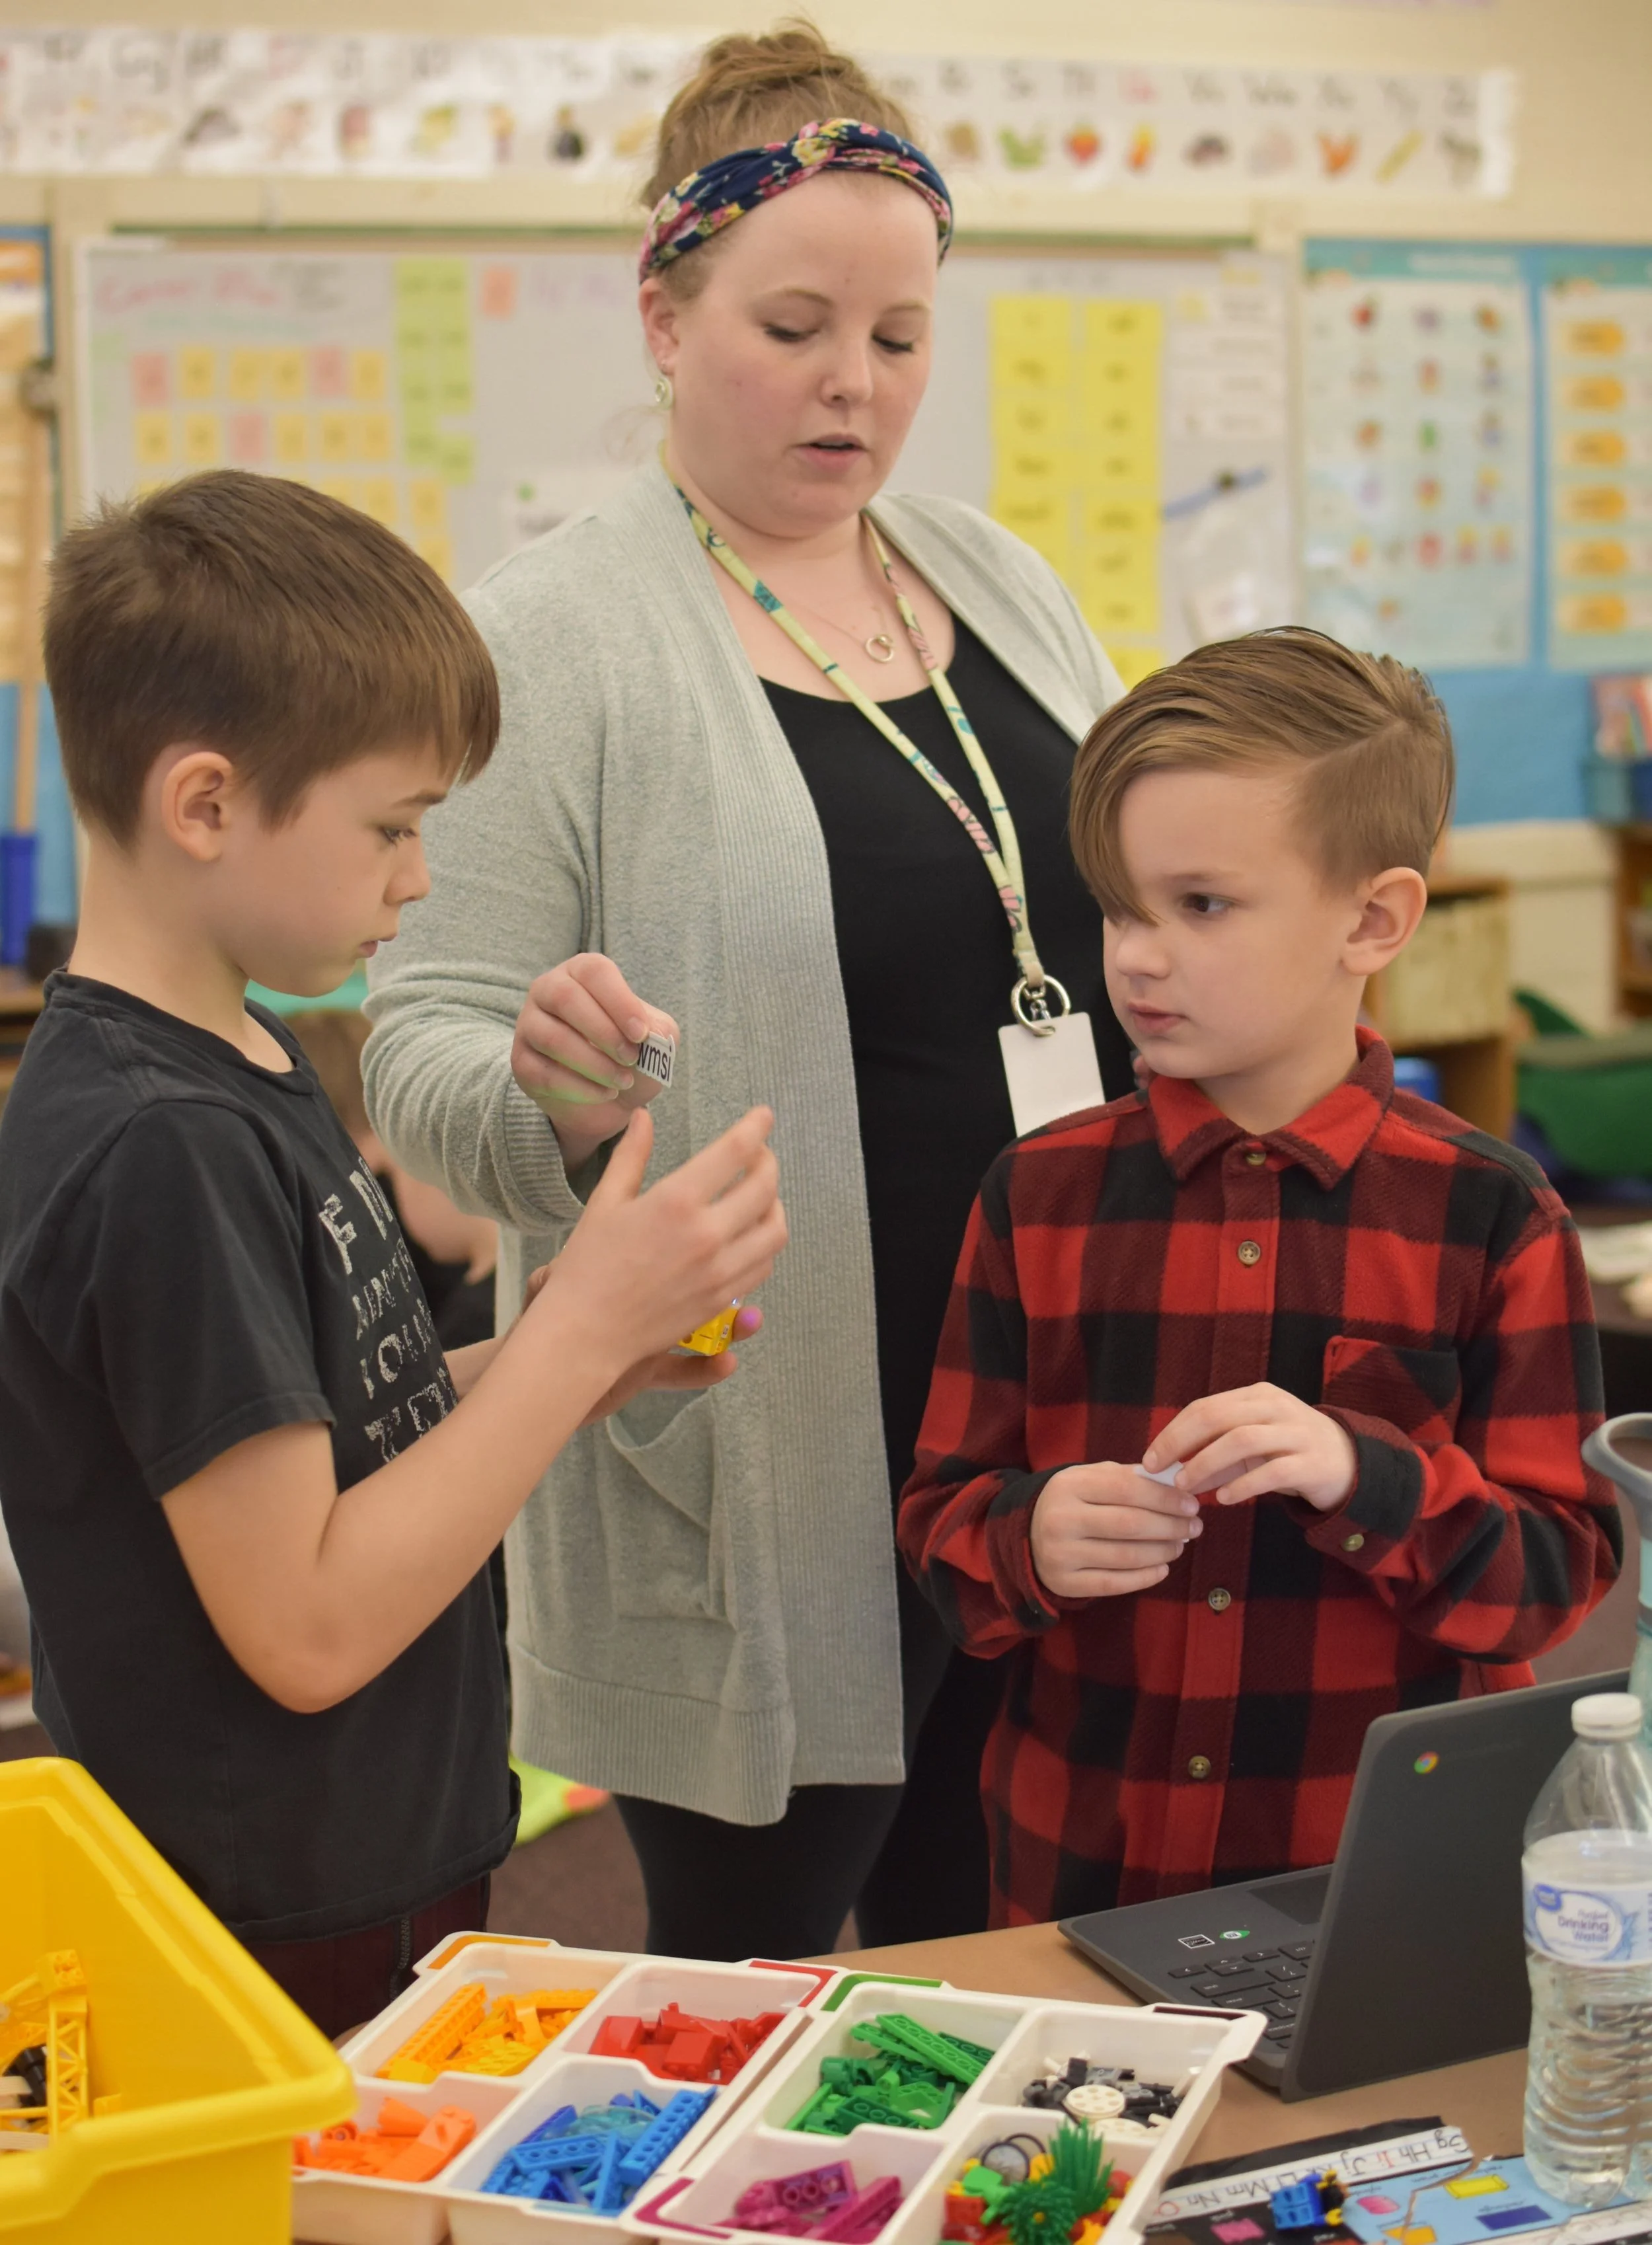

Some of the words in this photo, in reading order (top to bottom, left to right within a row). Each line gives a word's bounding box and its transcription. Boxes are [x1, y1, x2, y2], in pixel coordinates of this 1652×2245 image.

[1558, 1915, 1610, 1933] Drinking
[1573, 1931, 1609, 1942] Water
[1433, 2129, 1469, 2152] Gg
[1376, 2150, 1395, 2168] Ii
[1398, 2141, 1432, 2163] Hh
[1339, 2151, 1367, 2176] Jj
[1226, 2178, 1271, 2198] Mm
[1186, 2191, 1221, 2209] Nn
